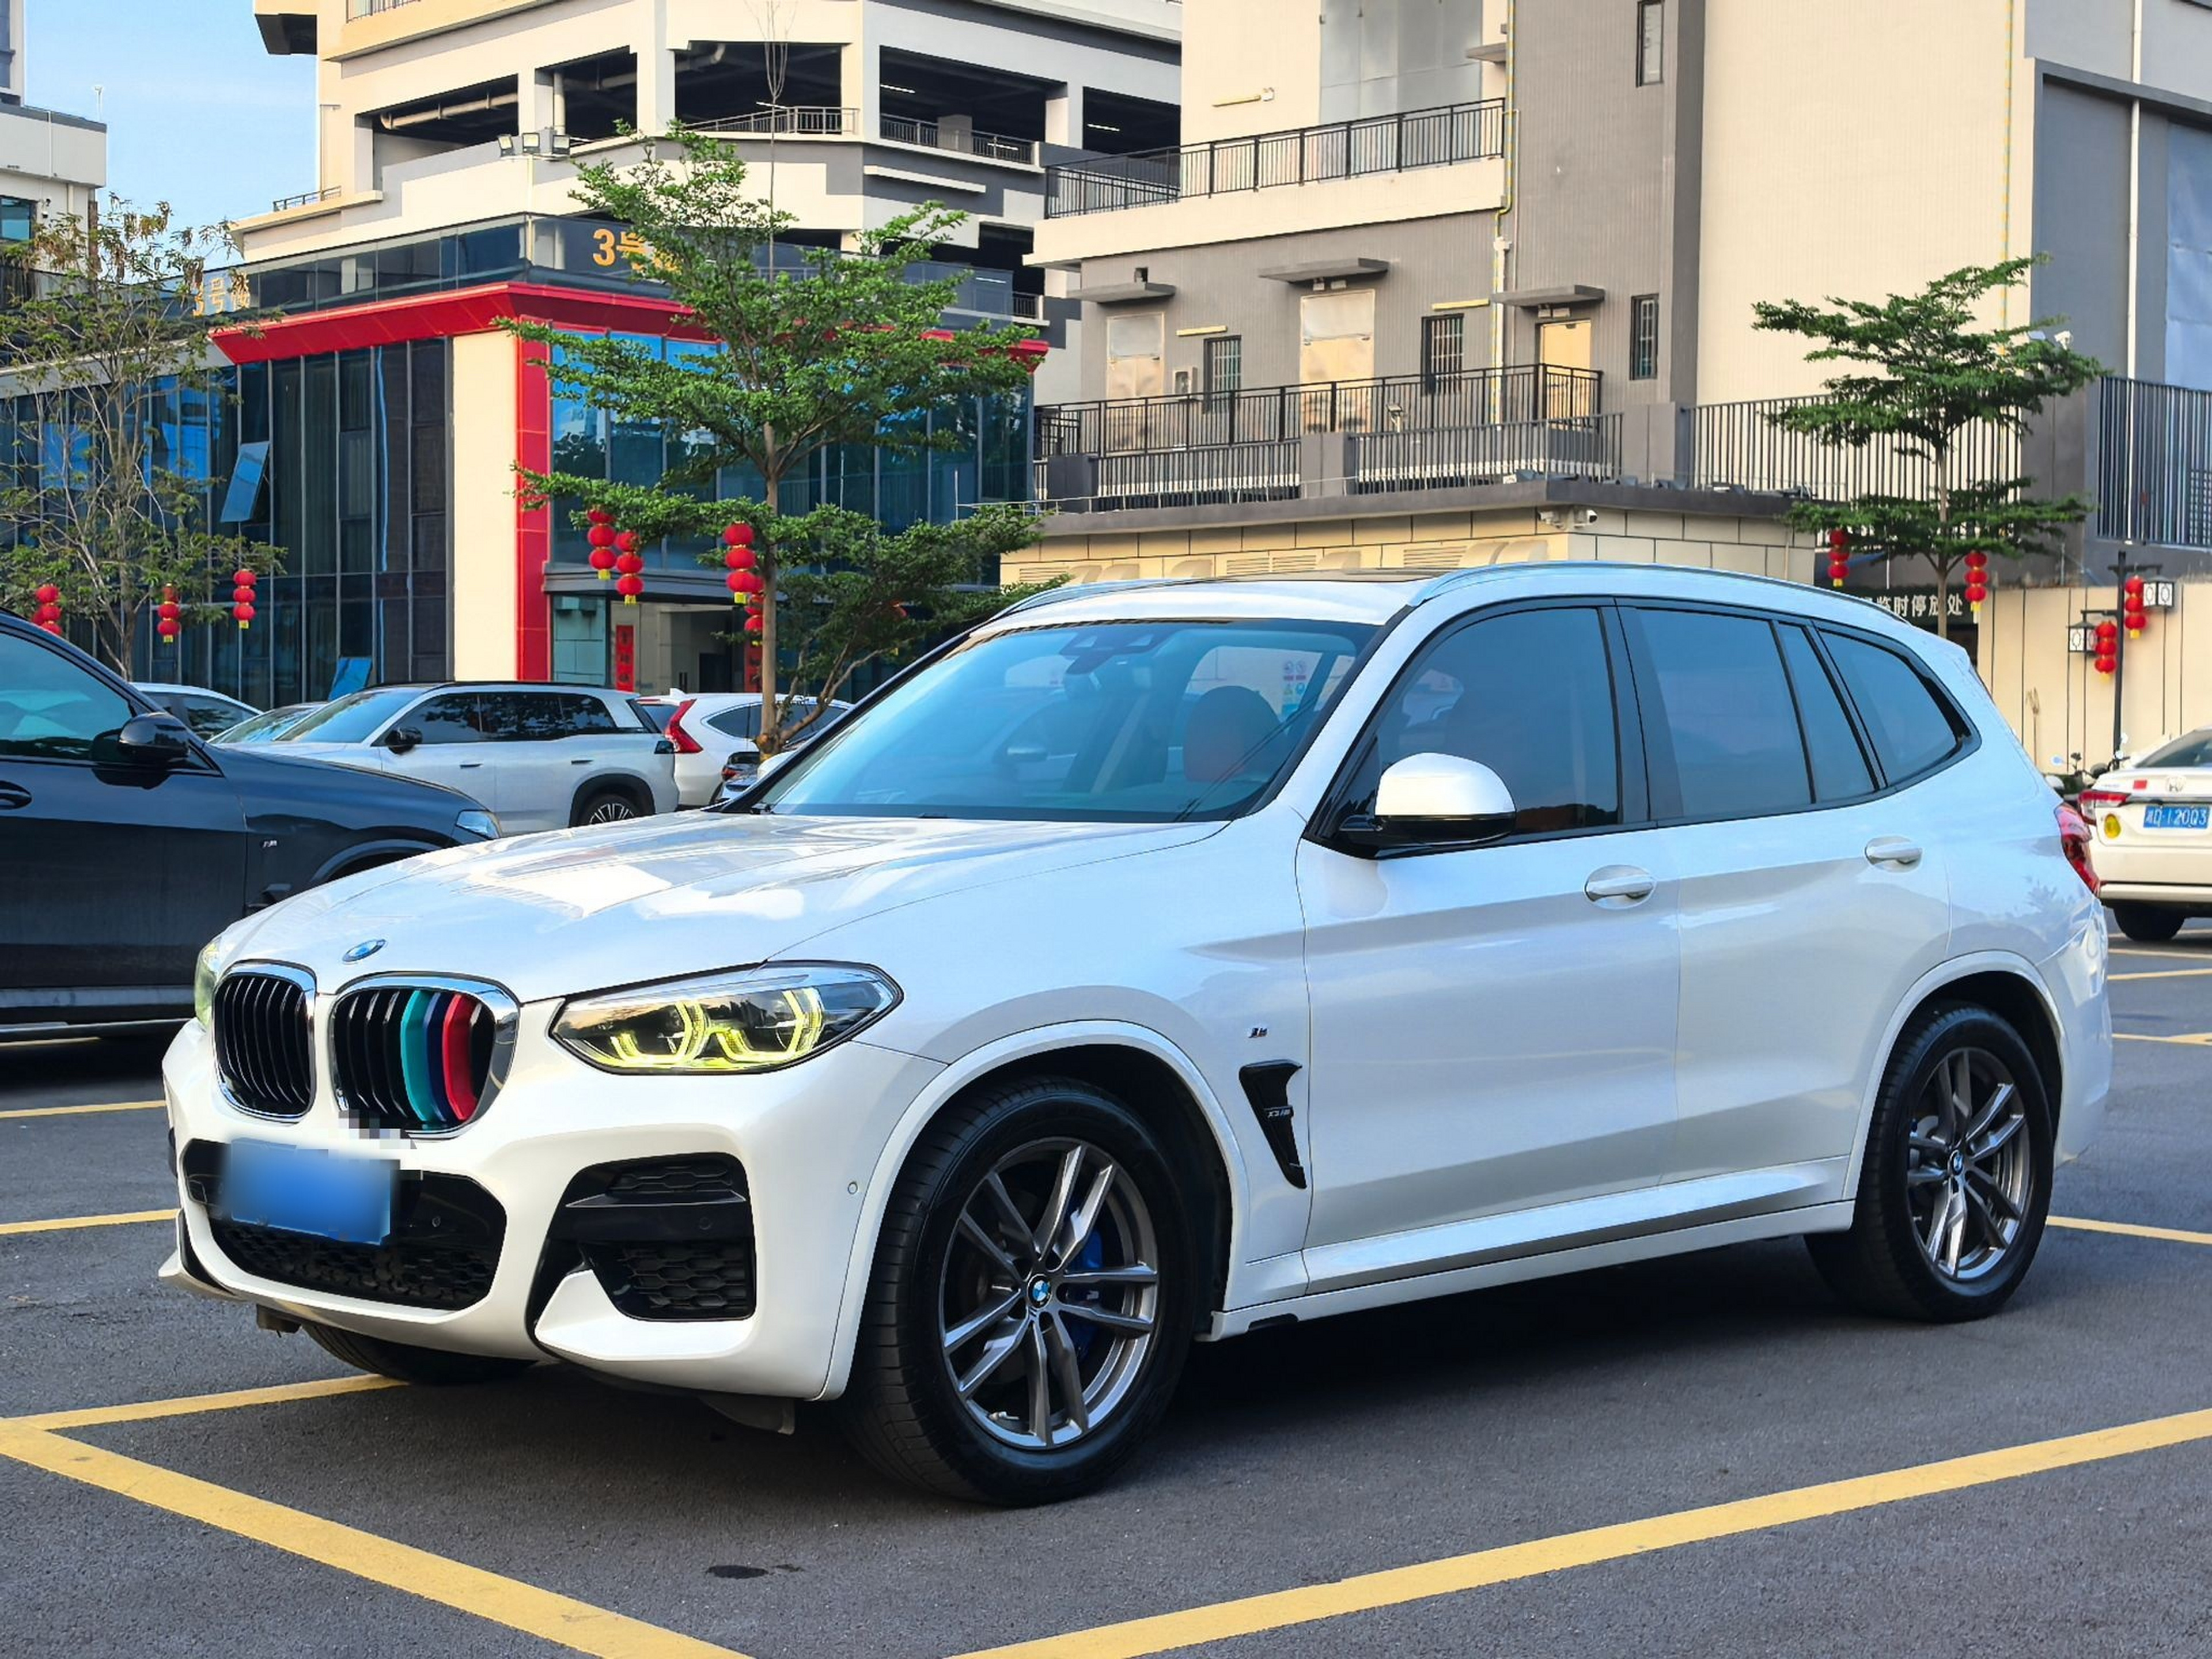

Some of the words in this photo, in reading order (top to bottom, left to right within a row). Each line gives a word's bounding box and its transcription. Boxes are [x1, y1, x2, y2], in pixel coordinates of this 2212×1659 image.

[593, 228, 681, 275] 3号
[1865, 593, 1963, 618] 临时停放处
